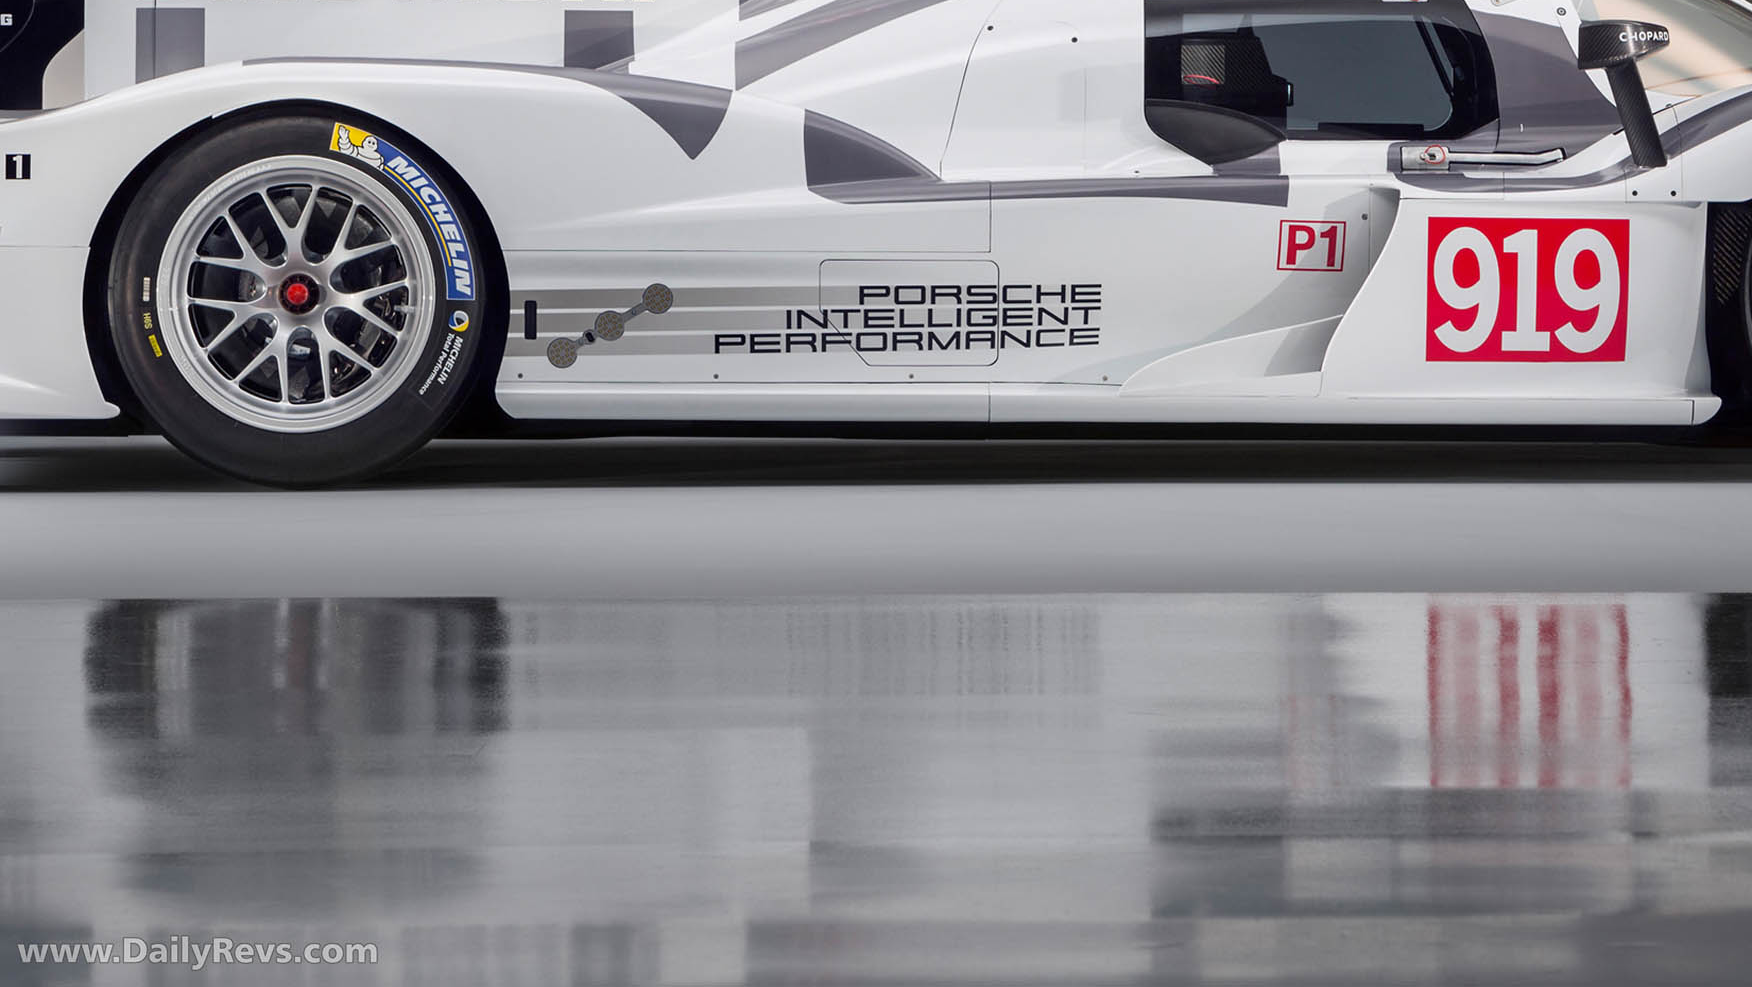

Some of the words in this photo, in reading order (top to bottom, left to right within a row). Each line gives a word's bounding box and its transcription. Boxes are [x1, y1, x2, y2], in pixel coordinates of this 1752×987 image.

[1619, 31, 1669, 42] CHOPARD
[386, 156, 472, 296] MICHELIN
[1285, 224, 1338, 267] P1
[858, 284, 1102, 305] PORSCHE
[1433, 226, 1621, 353] 919
[785, 306, 1101, 330] INTELLIGENT
[443, 332, 456, 352] Total
[714, 327, 1101, 354] PERFORMANCE
[418, 351, 448, 395] Performance
[437, 335, 464, 385] MICHELIN
